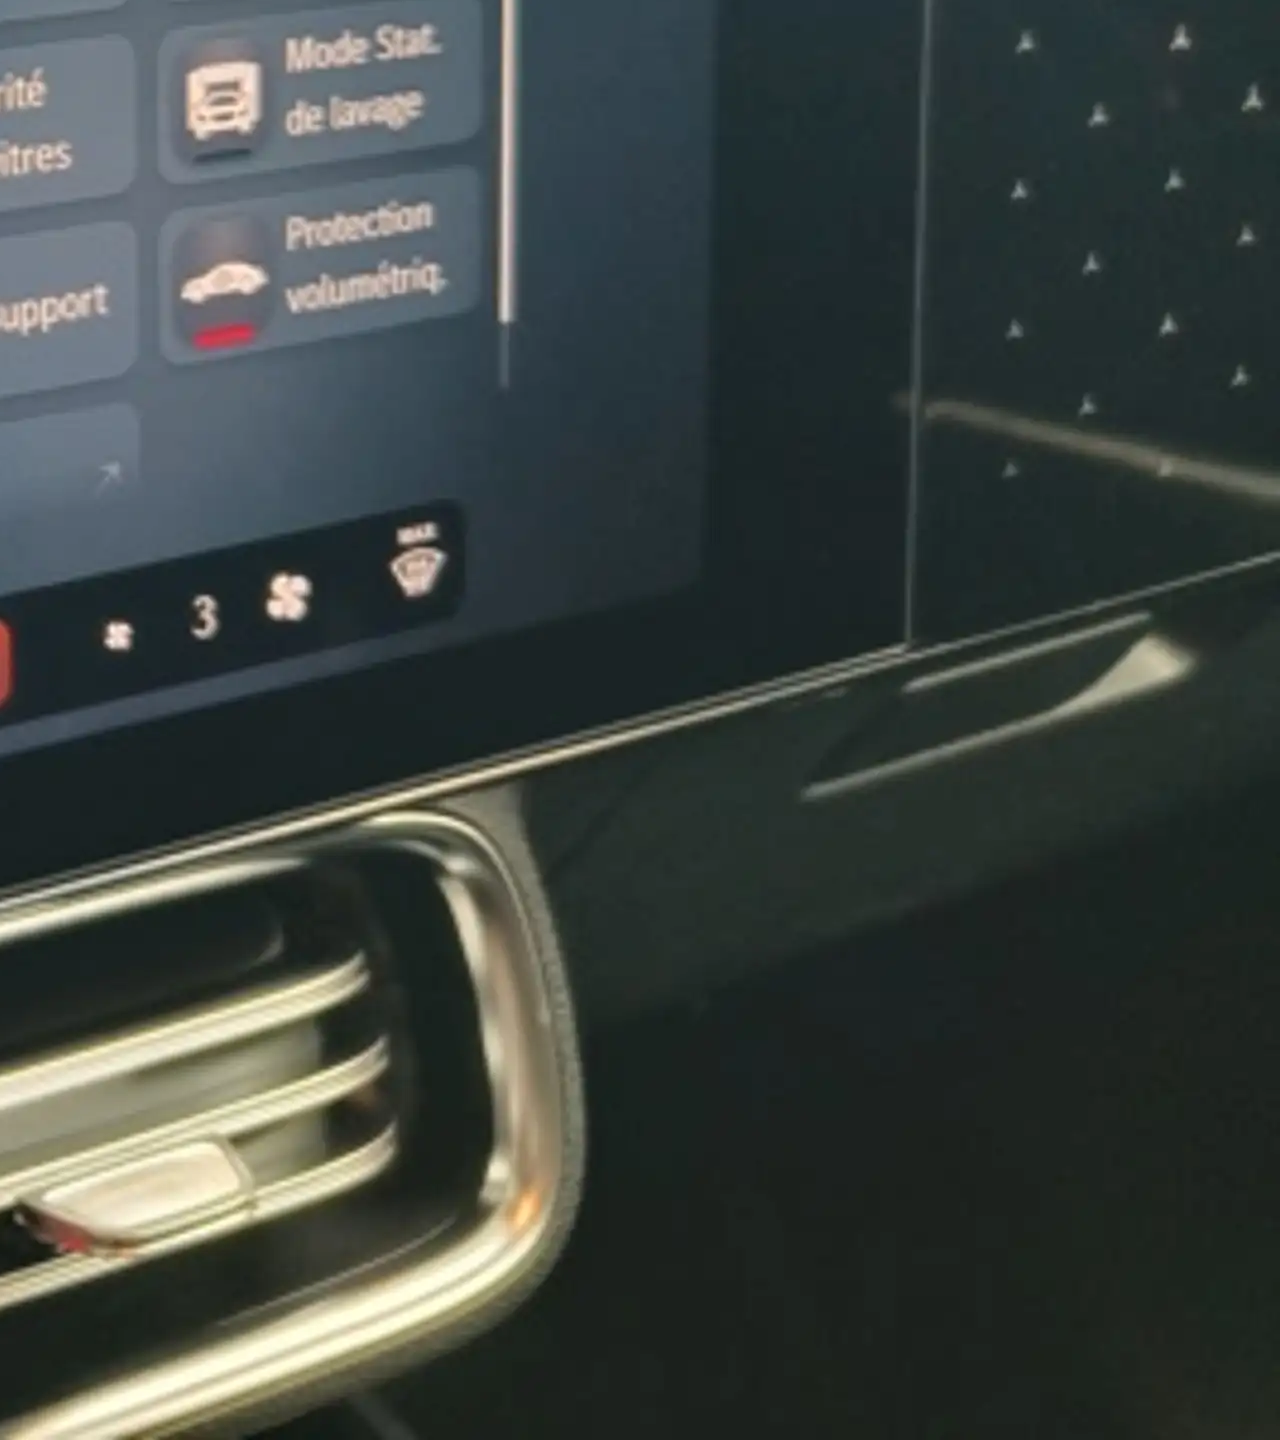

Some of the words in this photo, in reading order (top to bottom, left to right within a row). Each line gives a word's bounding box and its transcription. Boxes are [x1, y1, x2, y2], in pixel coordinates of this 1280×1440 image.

[286, 32, 368, 74] Mode
[373, 22, 443, 62] Stat.
[285, 100, 323, 137] de
[328, 87, 427, 136] lavage
[286, 200, 434, 252] Protection
[286, 258, 450, 316] volumétriq.
[191, 594, 219, 640] 3
